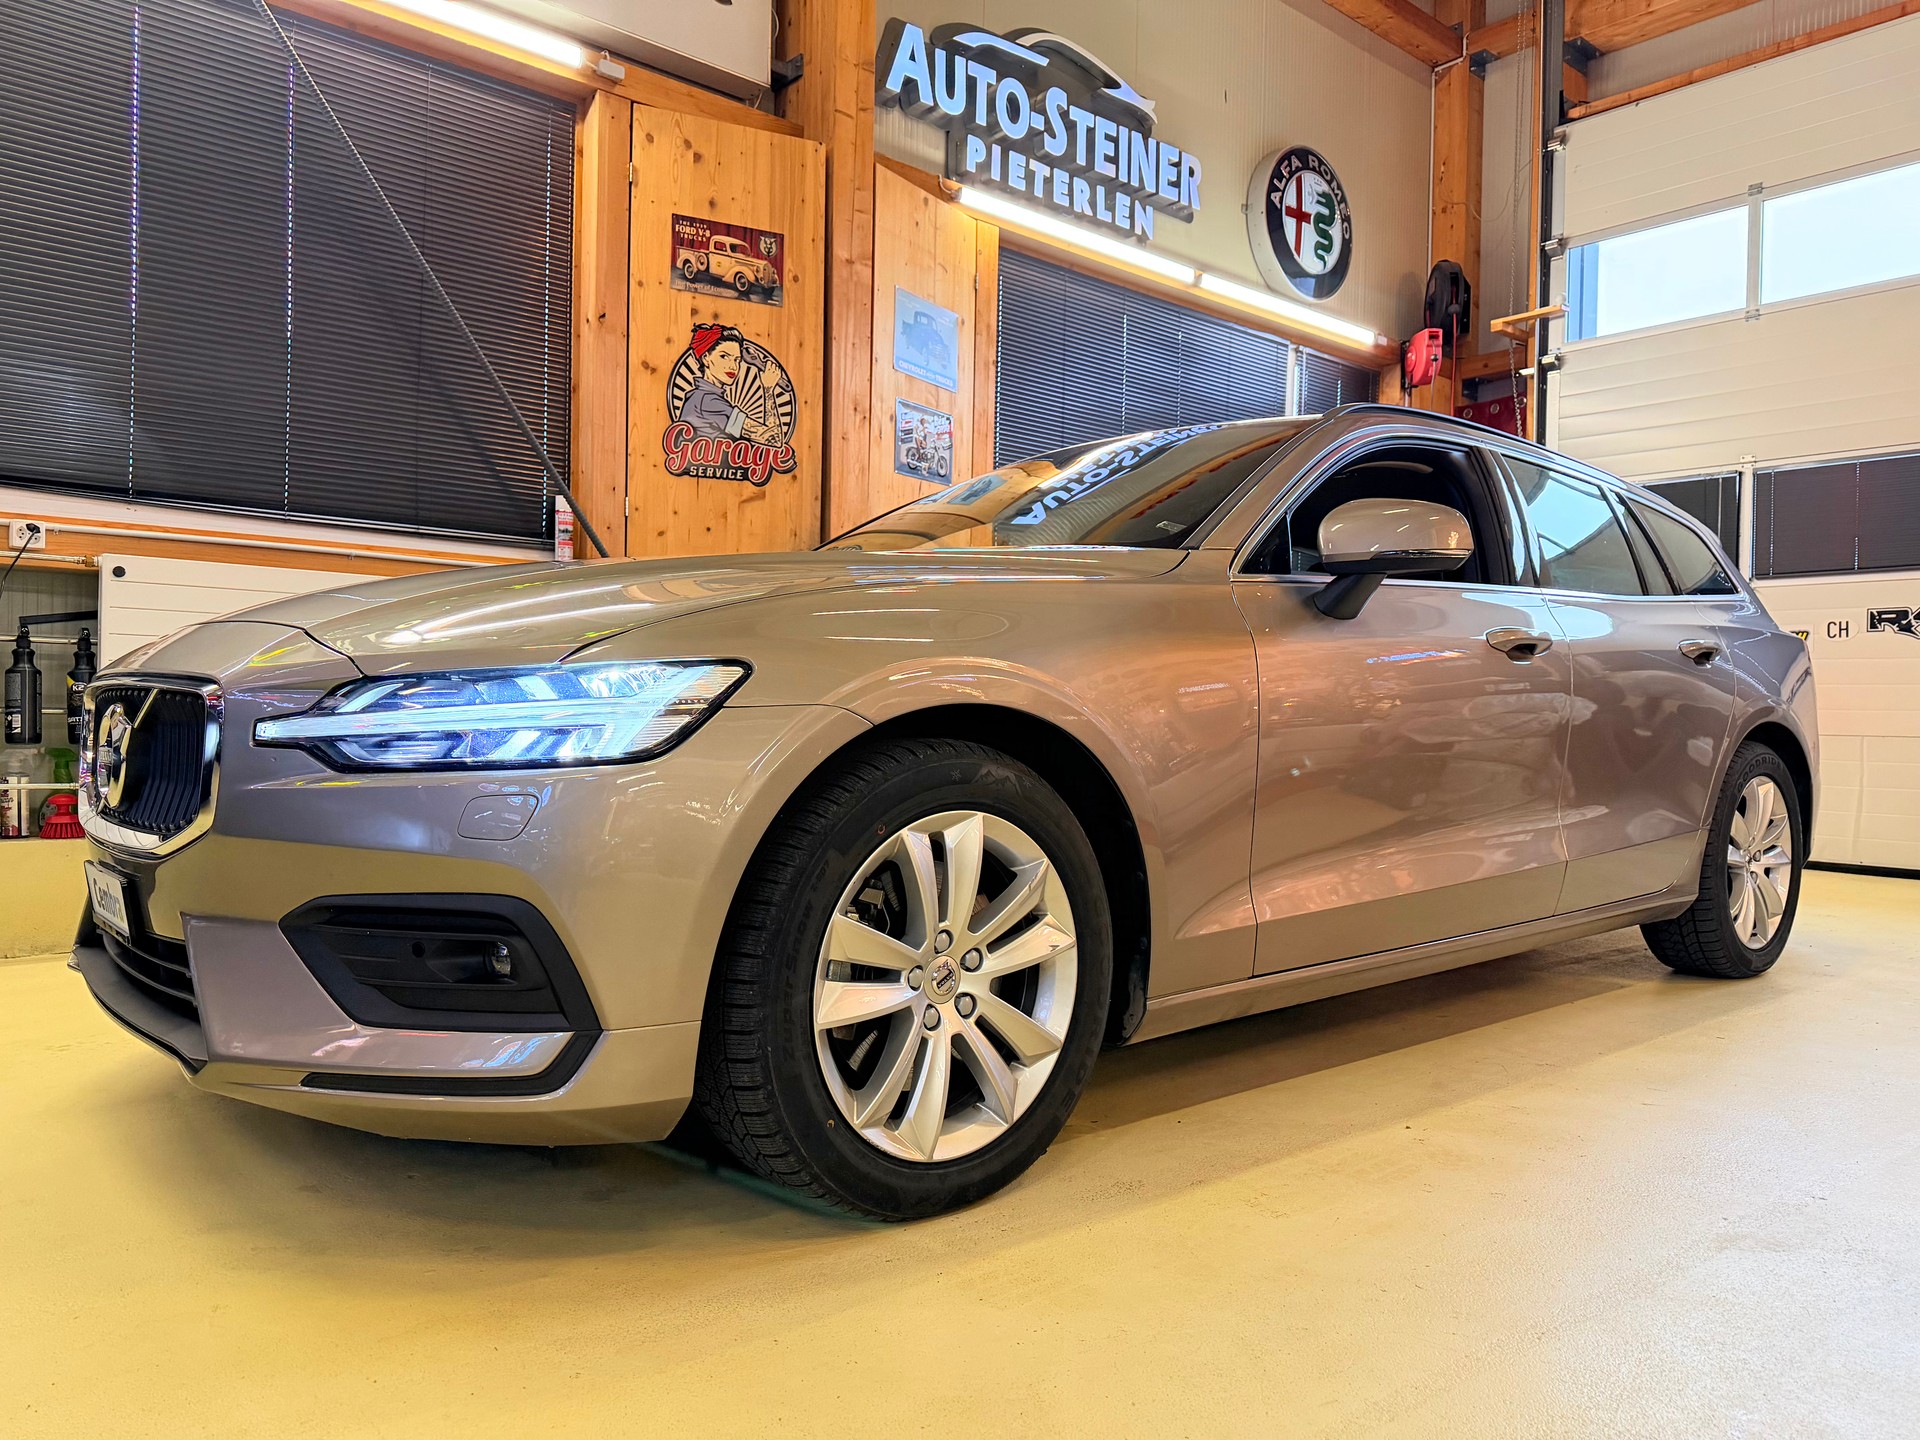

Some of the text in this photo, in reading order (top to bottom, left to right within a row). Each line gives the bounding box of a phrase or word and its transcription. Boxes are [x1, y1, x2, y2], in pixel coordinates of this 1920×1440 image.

[886, 23, 1202, 211] AUTO-STEINER
[966, 134, 1154, 241] PIETERLEN
[1270, 154, 1350, 240] ALFA ROMEO
[675, 224, 711, 238] FORD V-8
[680, 232, 707, 242] TRUCKS
[665, 421, 794, 483] Garage
[690, 466, 744, 479] SERVICE
[1827, 621, 1849, 638] CH
[72, 684, 85, 692] K2
[93, 878, 125, 924] Cembra
